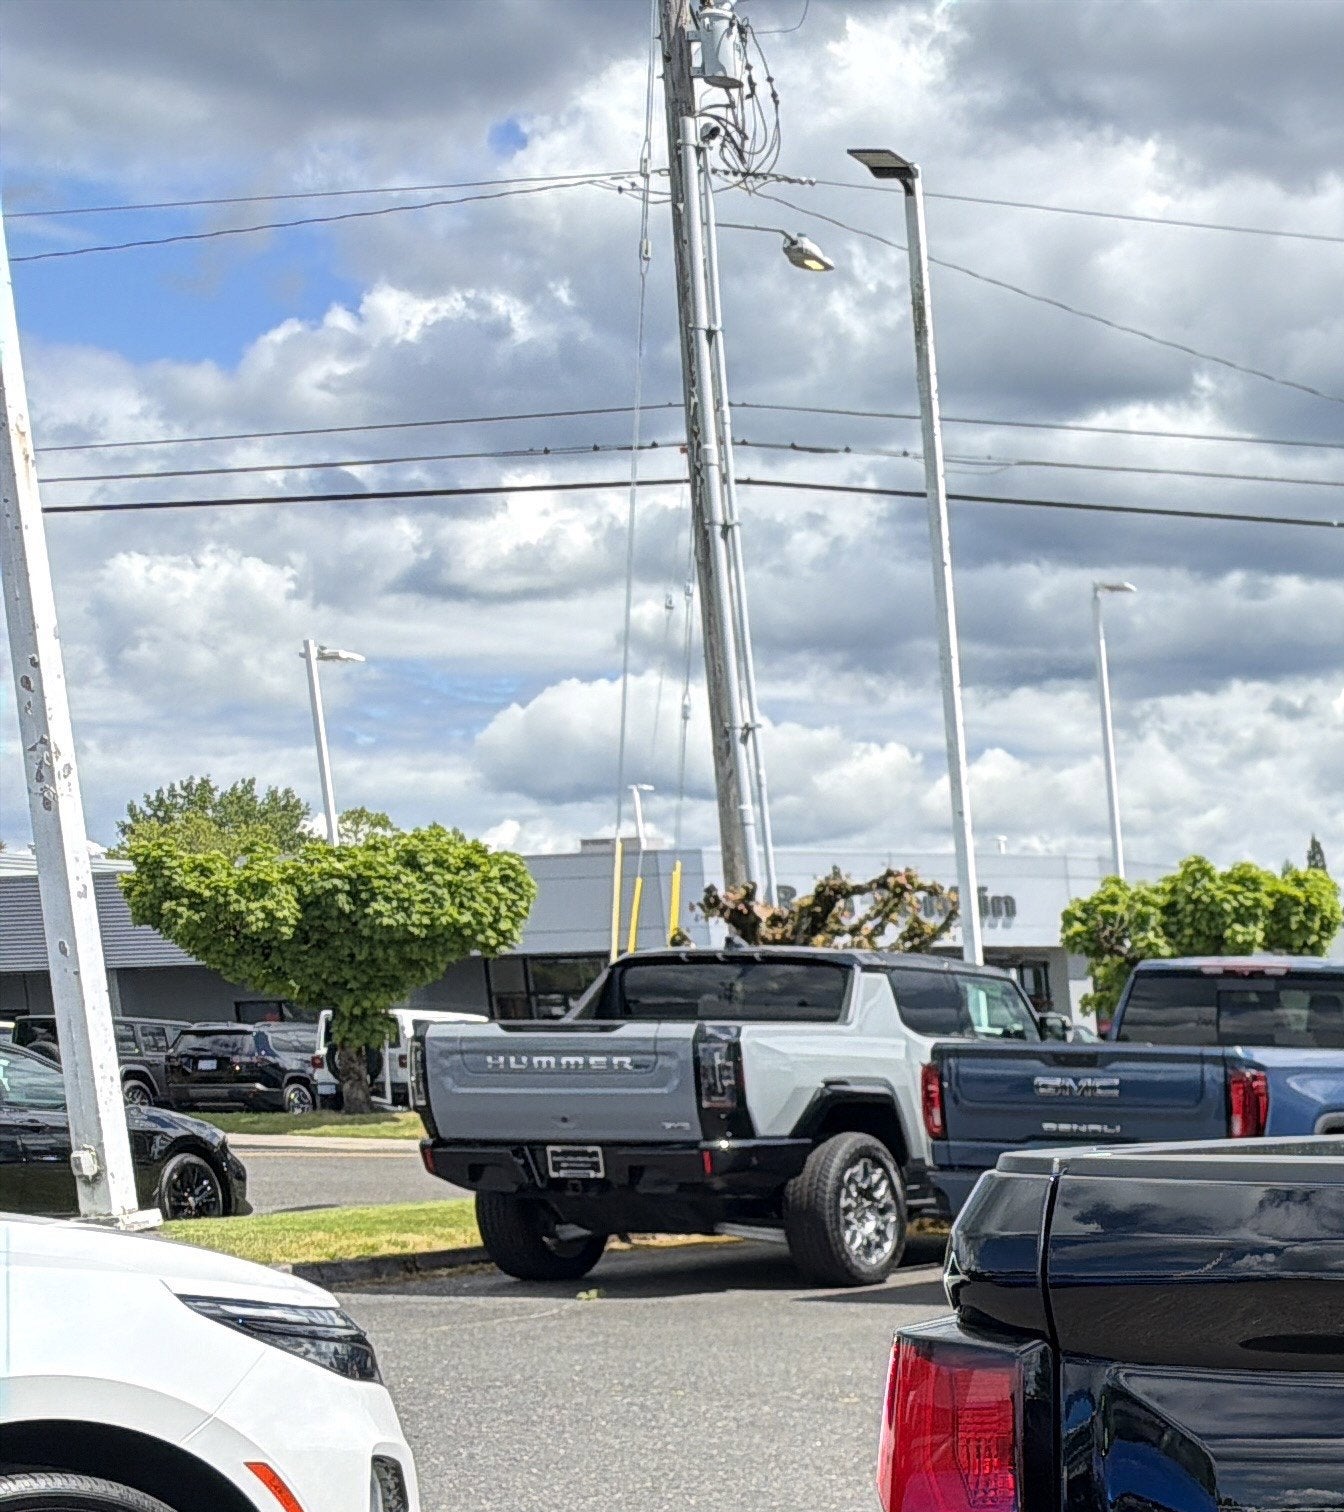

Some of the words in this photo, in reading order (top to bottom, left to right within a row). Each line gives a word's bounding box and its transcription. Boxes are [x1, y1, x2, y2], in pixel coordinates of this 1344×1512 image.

[486, 1055, 634, 1070] HUMMER
[1033, 1076, 1120, 1098] GMC
[1041, 1122, 1121, 1134] DENALI
